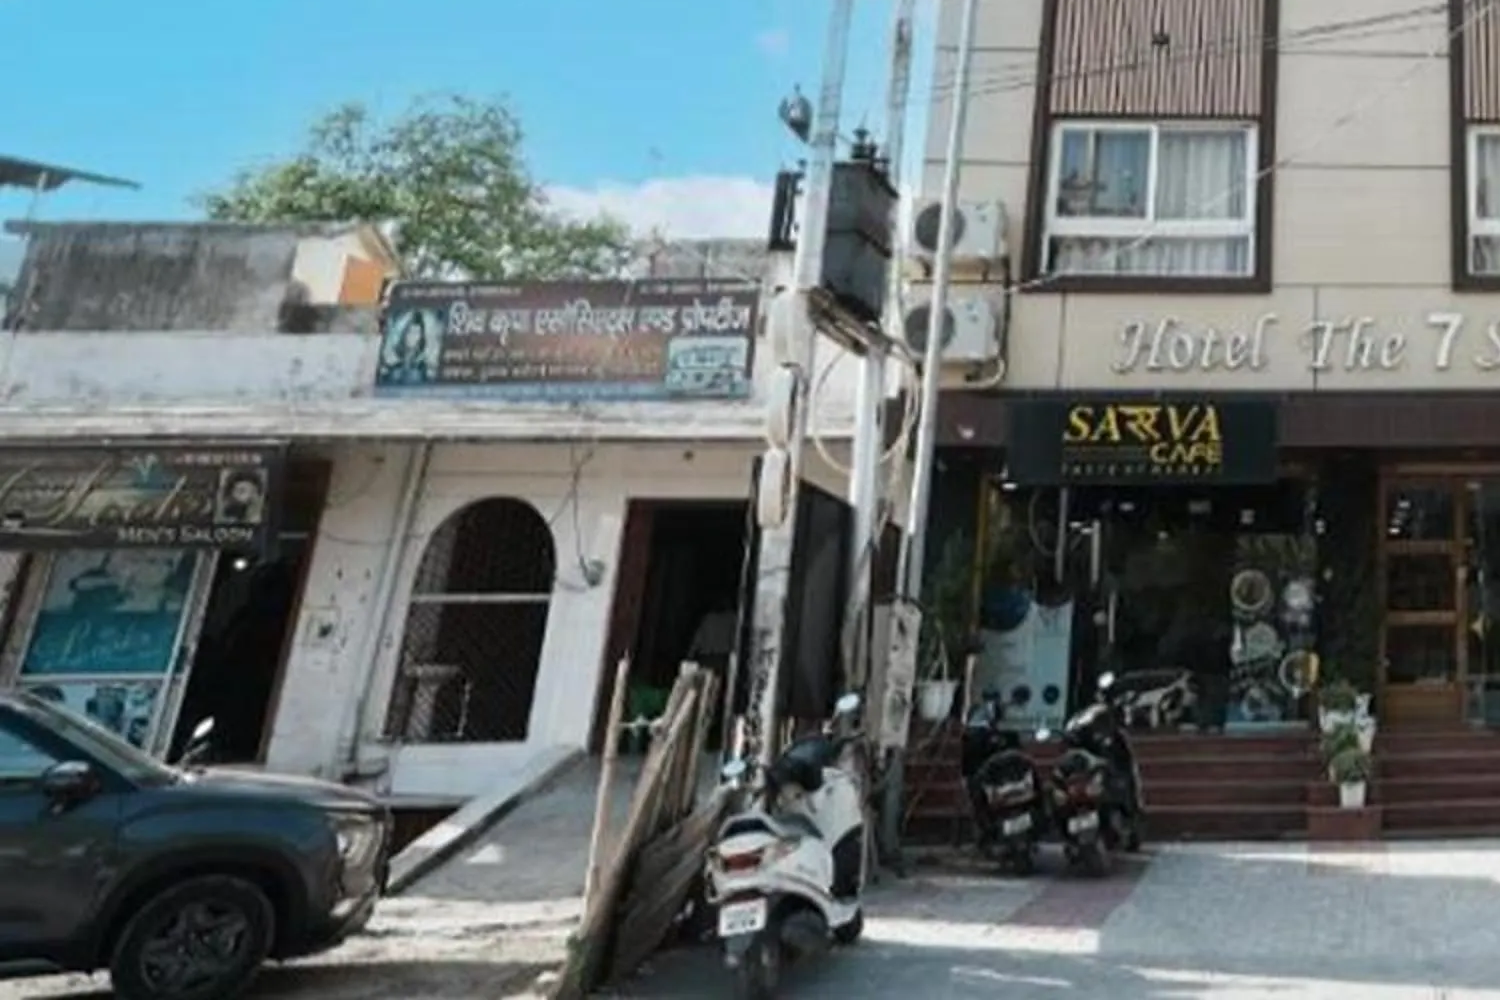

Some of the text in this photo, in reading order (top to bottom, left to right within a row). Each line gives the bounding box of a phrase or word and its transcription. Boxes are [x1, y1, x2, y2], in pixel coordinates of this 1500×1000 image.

[1112, 312, 1280, 374] Hotel
[1307, 317, 1407, 374] The
[1427, 312, 1466, 371] 7
